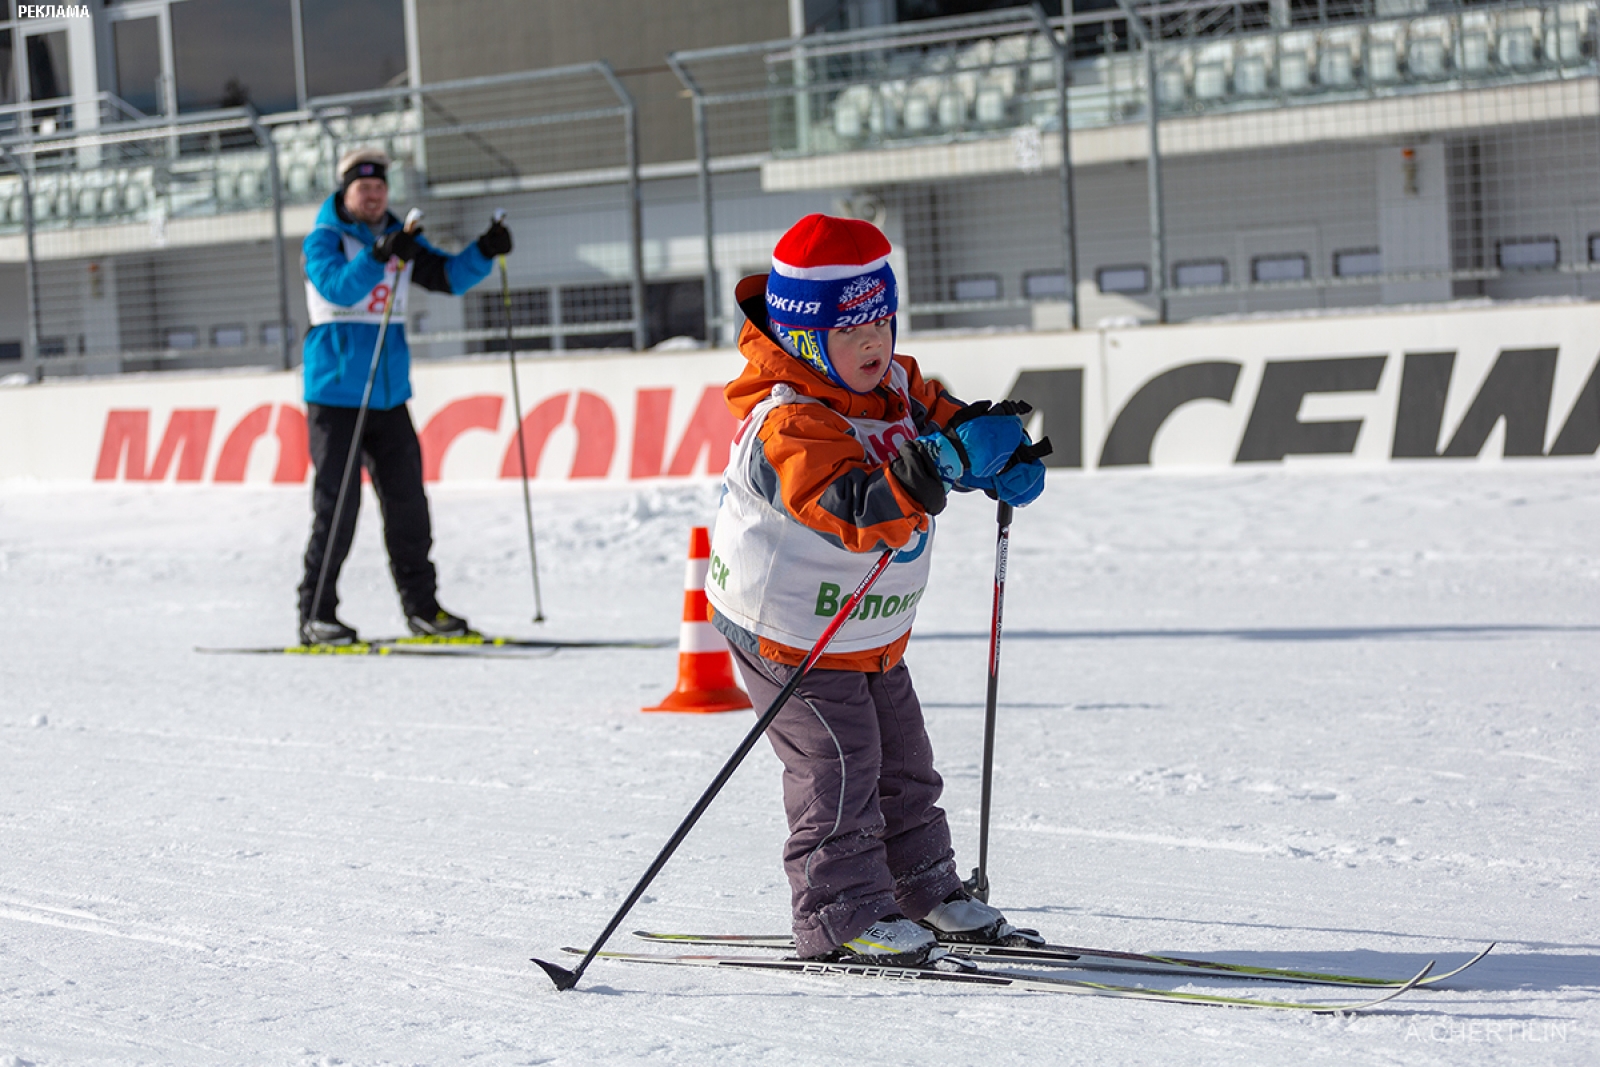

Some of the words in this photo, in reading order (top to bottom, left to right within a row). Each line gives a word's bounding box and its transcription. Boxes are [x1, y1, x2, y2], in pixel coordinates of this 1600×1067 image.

[834, 305, 888, 327] 2018
[94, 385, 739, 483] MOCOW
[990, 347, 1600, 469] ACEW
[709, 548, 730, 592] ск
[802, 964, 920, 980] FISCHER
